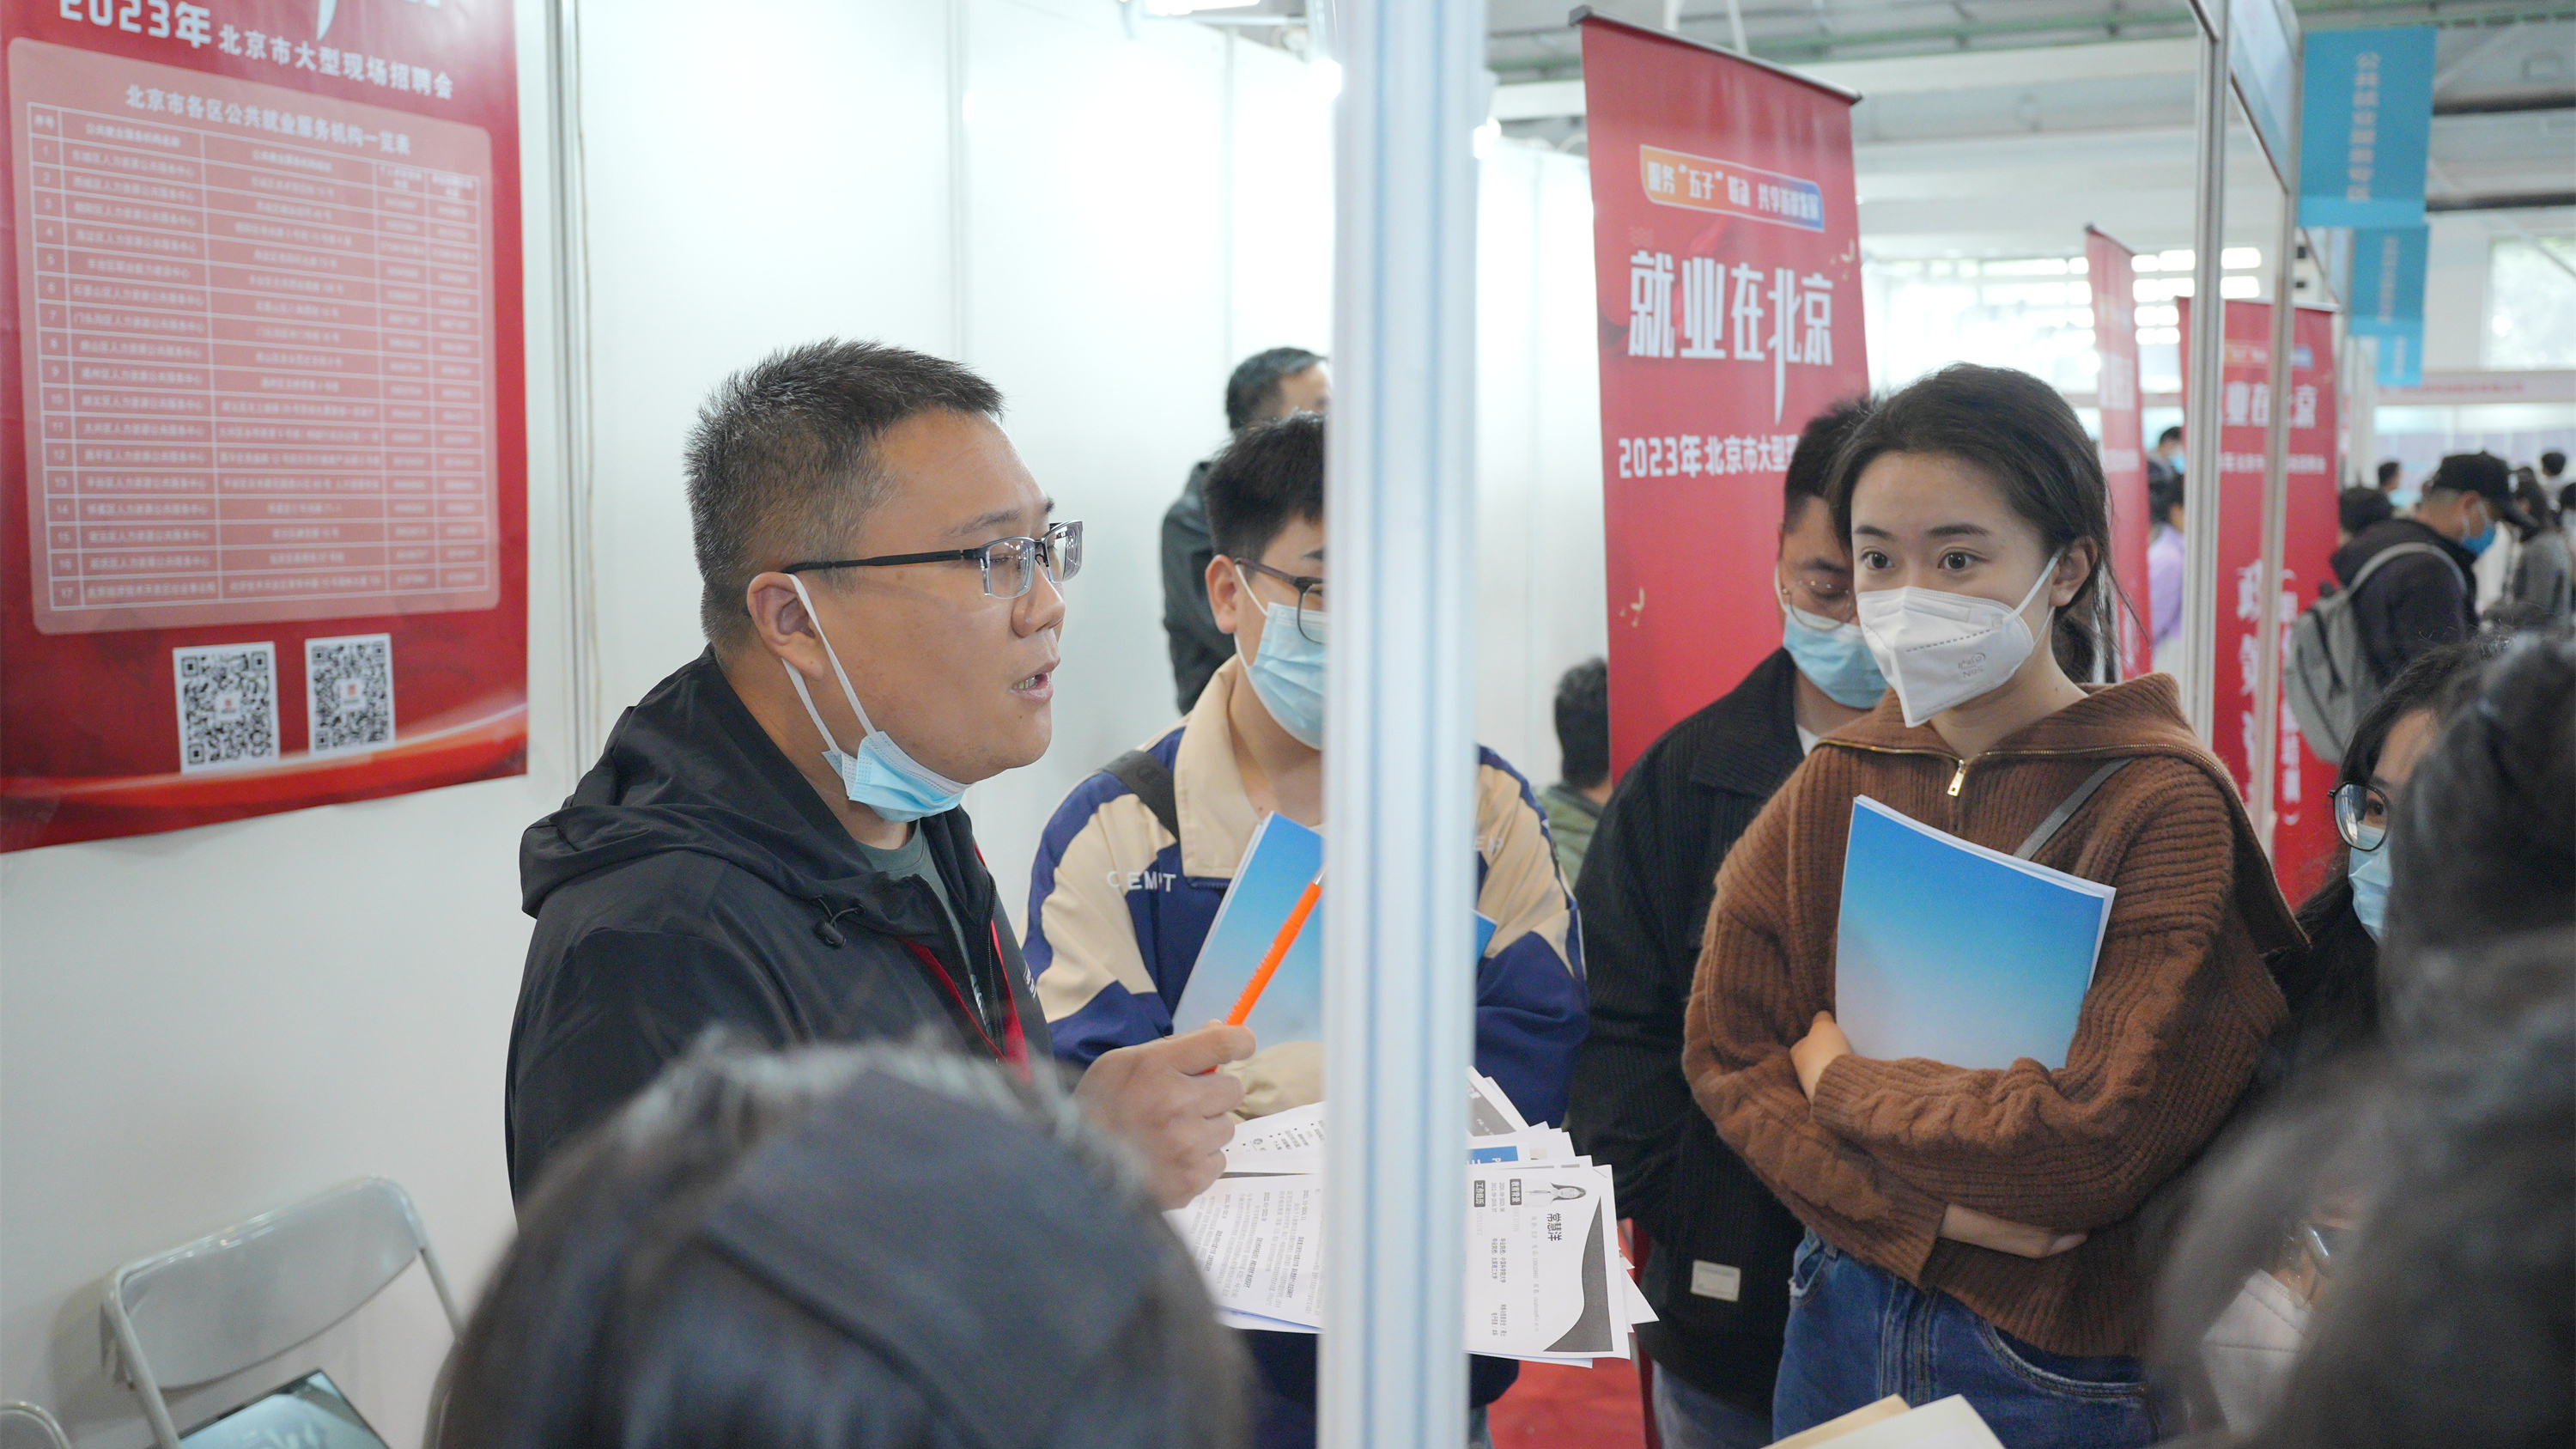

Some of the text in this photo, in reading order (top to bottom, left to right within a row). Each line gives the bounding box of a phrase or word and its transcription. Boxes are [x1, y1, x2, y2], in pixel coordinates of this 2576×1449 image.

[126, 84, 410, 155] 北京市各区公共就业服务机构一览表
[1629, 249, 1833, 427] 就业在北京
[1511, 1181, 1521, 1202] 教育背景
[1546, 1213, 1562, 1241] 常慧洋
